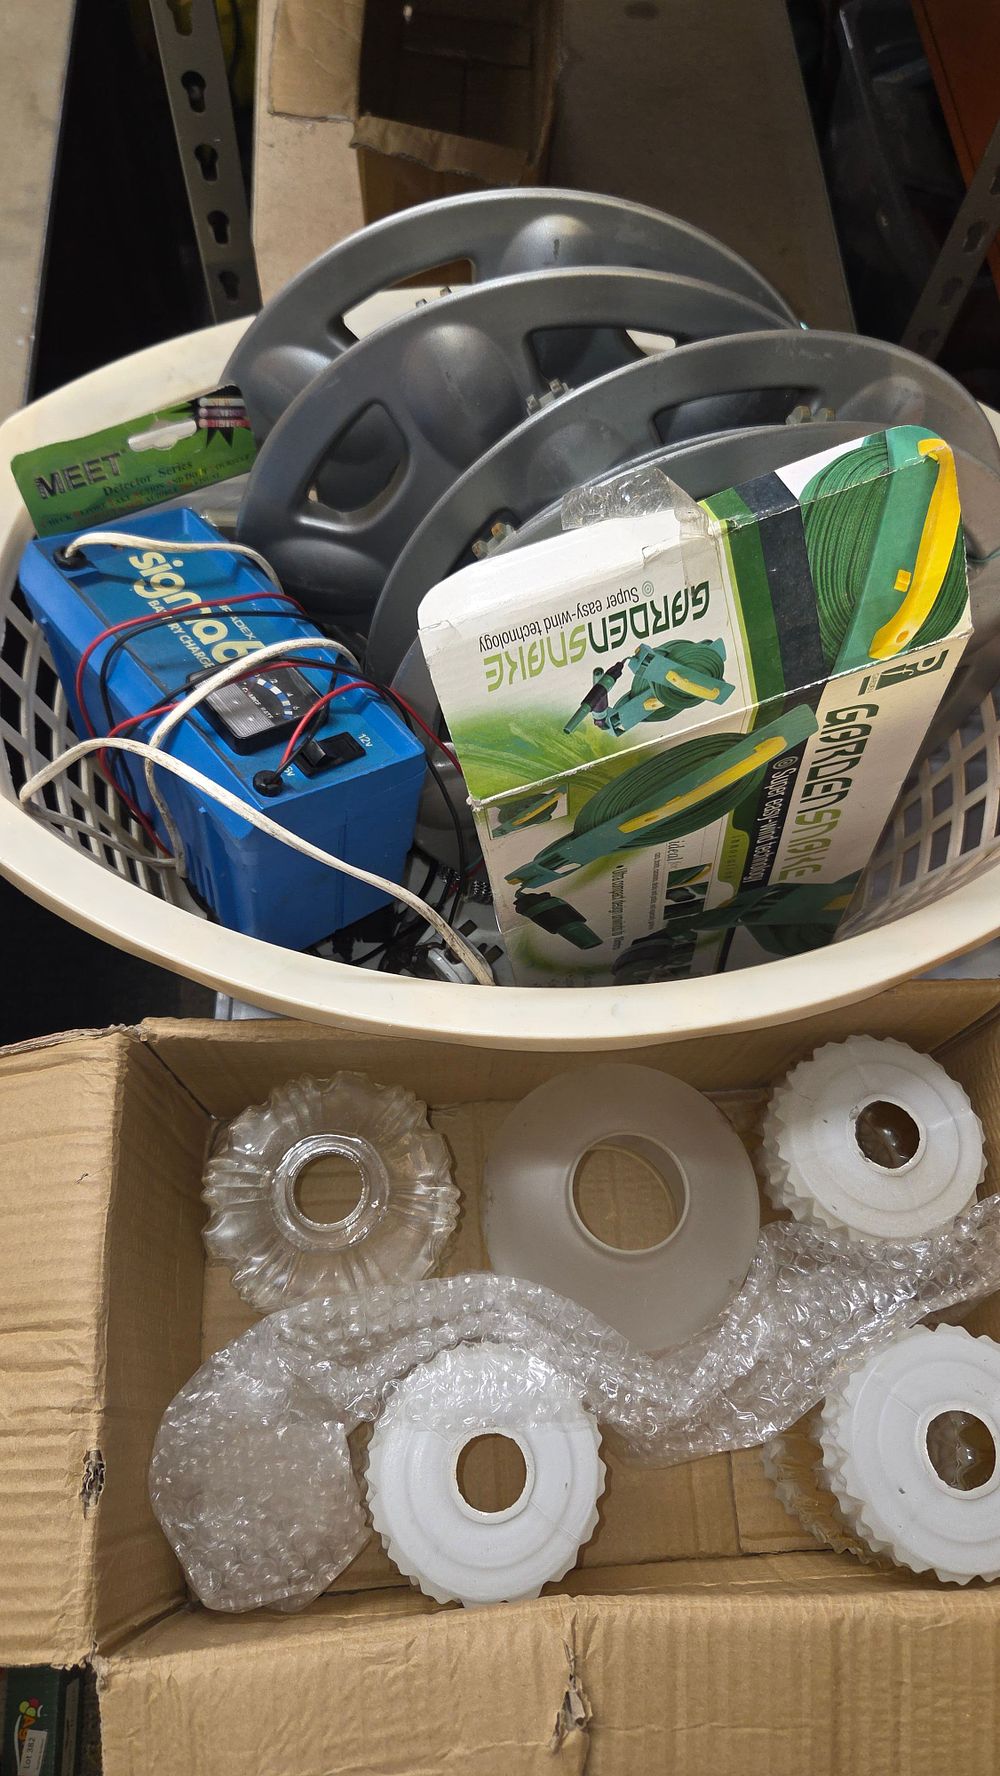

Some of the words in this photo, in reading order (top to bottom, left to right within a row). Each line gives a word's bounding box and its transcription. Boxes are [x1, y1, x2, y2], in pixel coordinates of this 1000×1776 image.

[34, 452, 121, 499] MEET
[103, 476, 151, 497] Detector
[159, 461, 193, 478] Series
[545, 598, 603, 634] easy-wind
[606, 587, 640, 611] Super
[479, 622, 543, 653] technology
[768, 767, 797, 797] Super
[757, 796, 784, 844] easy-wind
[667, 840, 685, 862] ideal
[743, 841, 777, 883] technology
